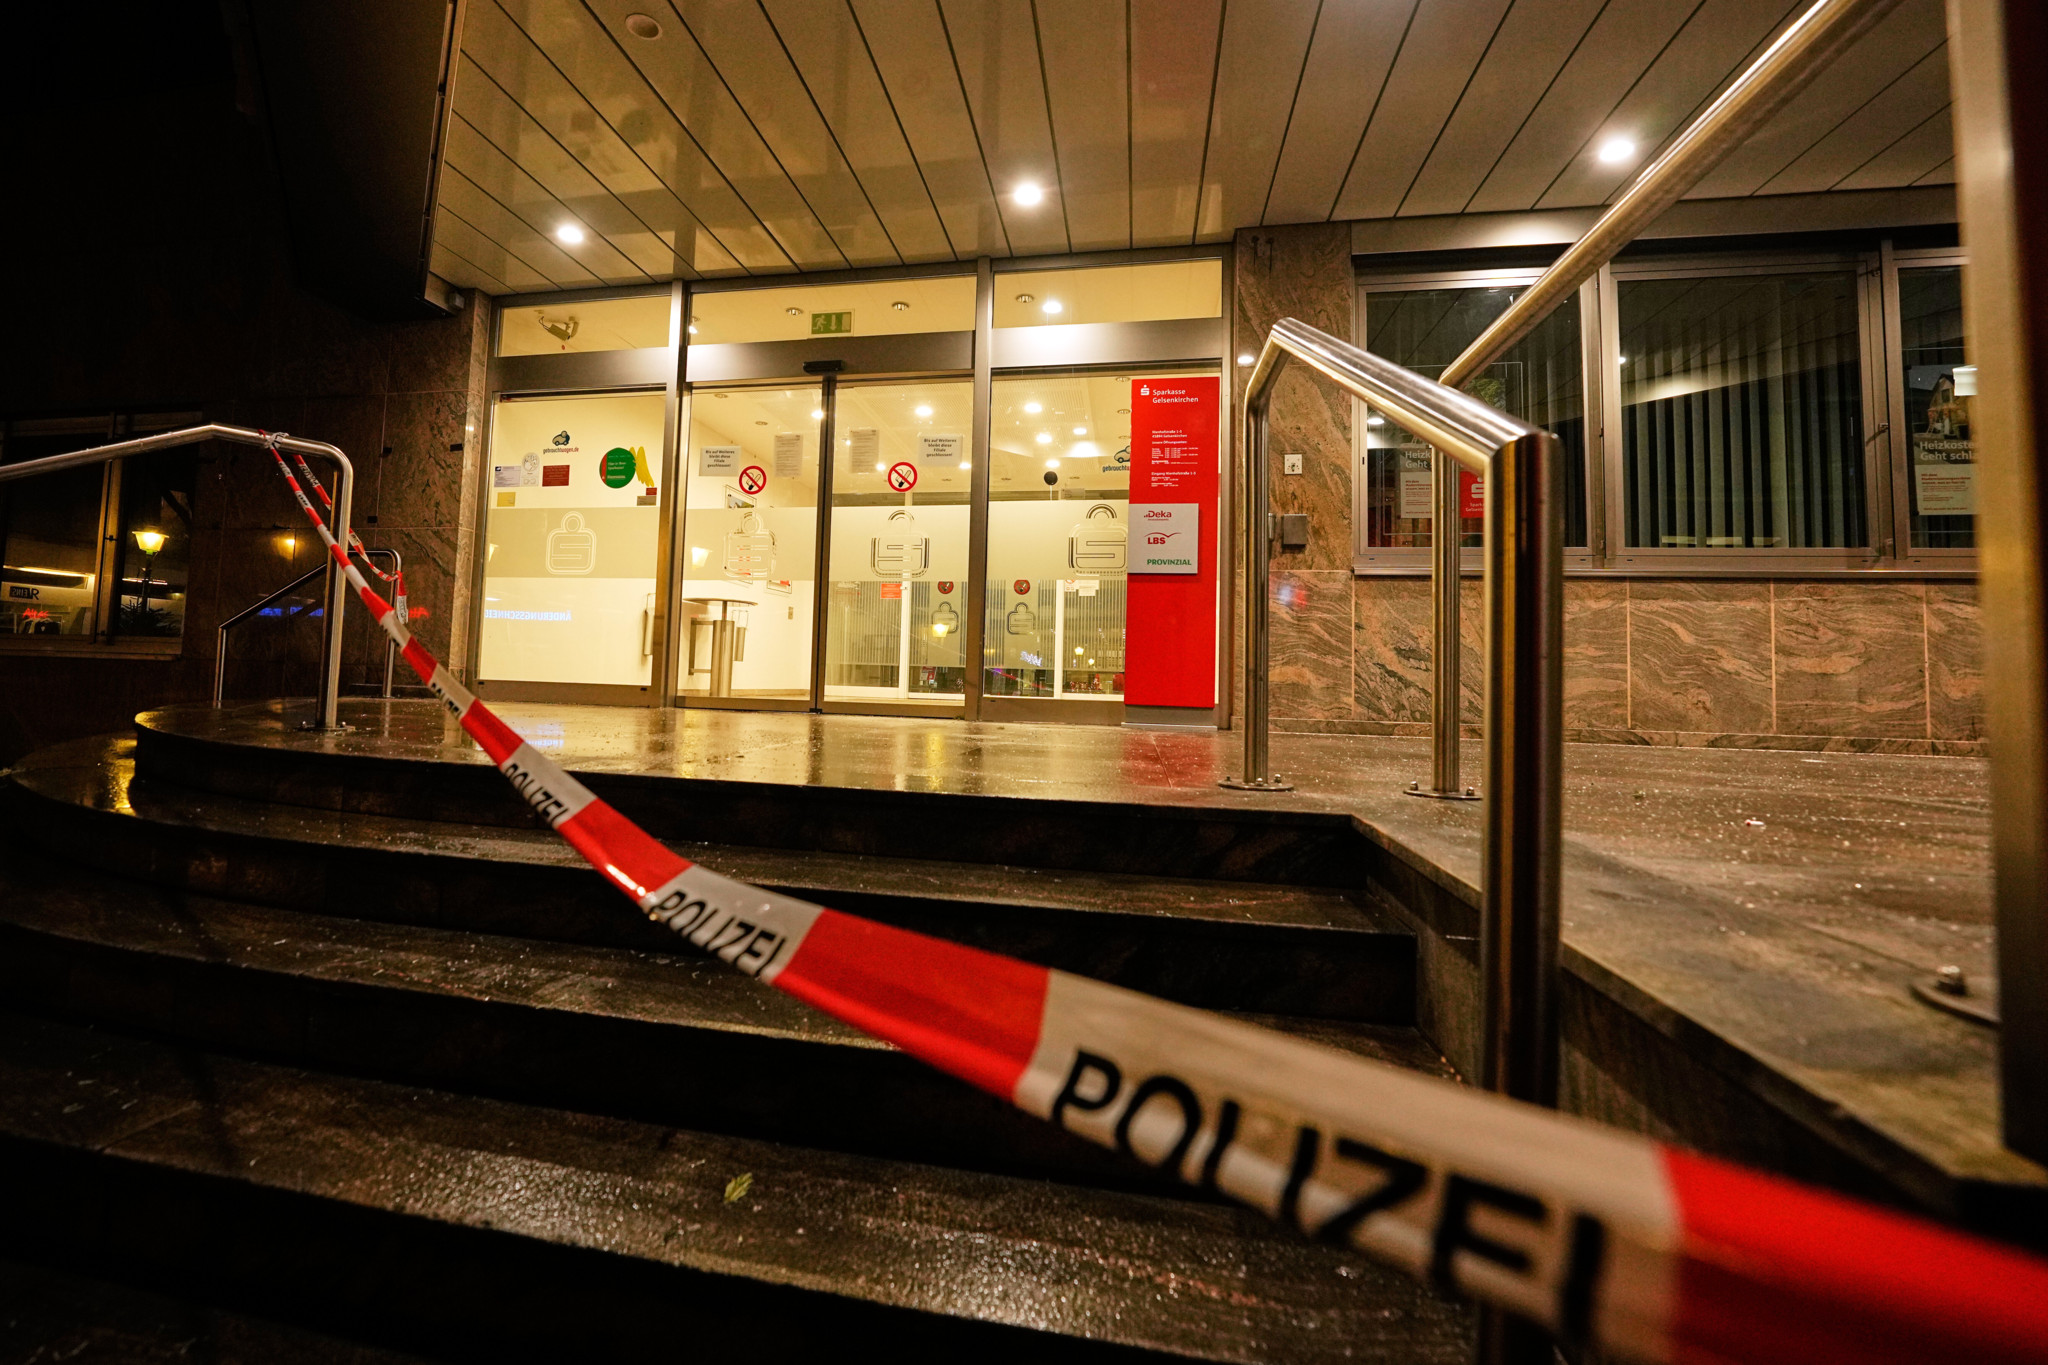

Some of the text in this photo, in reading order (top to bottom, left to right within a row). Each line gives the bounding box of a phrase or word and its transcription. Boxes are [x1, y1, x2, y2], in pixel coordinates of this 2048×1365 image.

[1920, 440, 1975, 450] Heizkoste
[1405, 450, 1432, 459] Heizk
[1920, 451, 1974, 460] Geht schl
[651, 890, 787, 977] POLIZEI
[1050, 1048, 1608, 1342] POLIZEI
